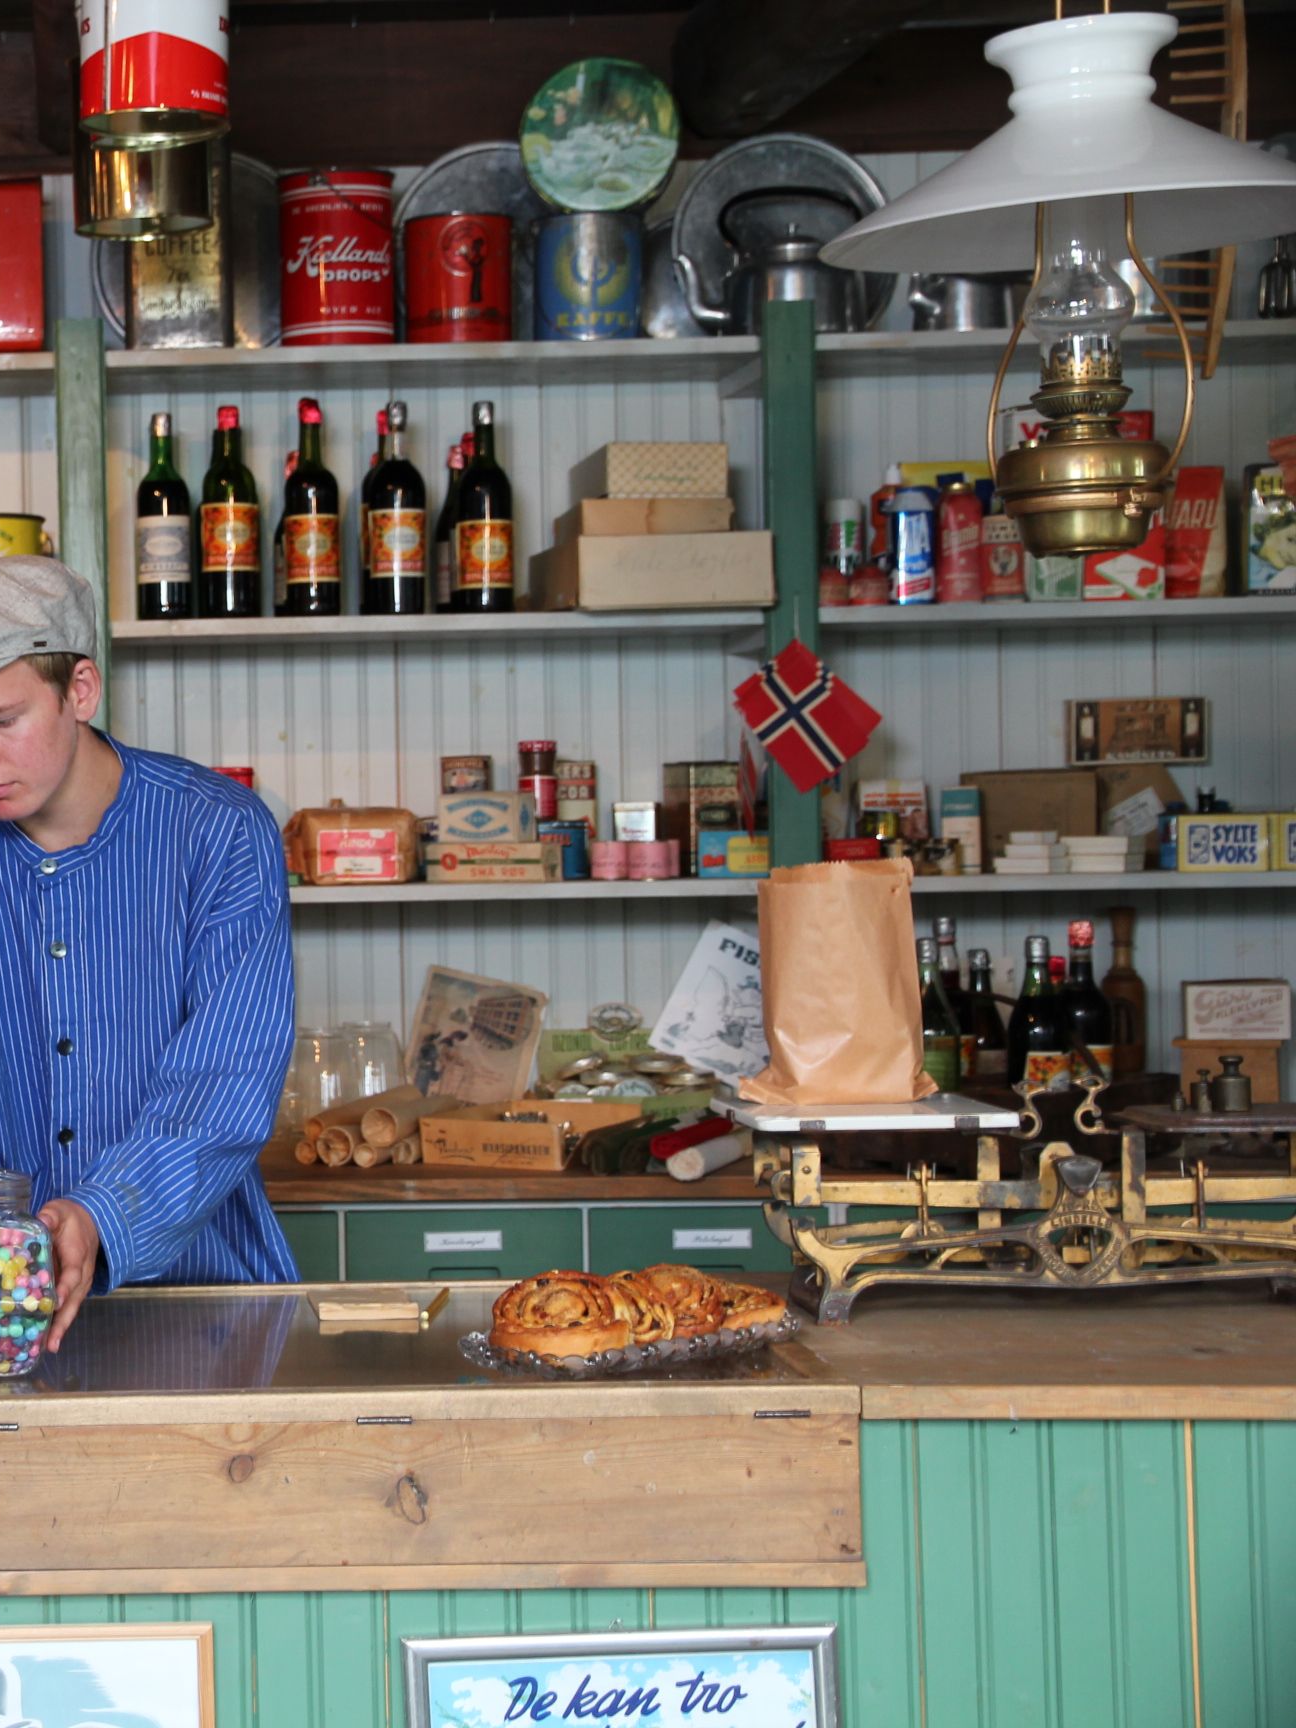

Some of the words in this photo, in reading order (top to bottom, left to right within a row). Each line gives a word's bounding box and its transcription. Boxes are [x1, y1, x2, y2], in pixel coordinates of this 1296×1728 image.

[323, 268, 382, 282] DROPS
[1212, 824, 1257, 843] SYLTE
[1212, 845, 1257, 863] VOKS
[504, 1675, 558, 1721] De
[561, 1673, 663, 1720] kan
[675, 1671, 748, 1713] tro
